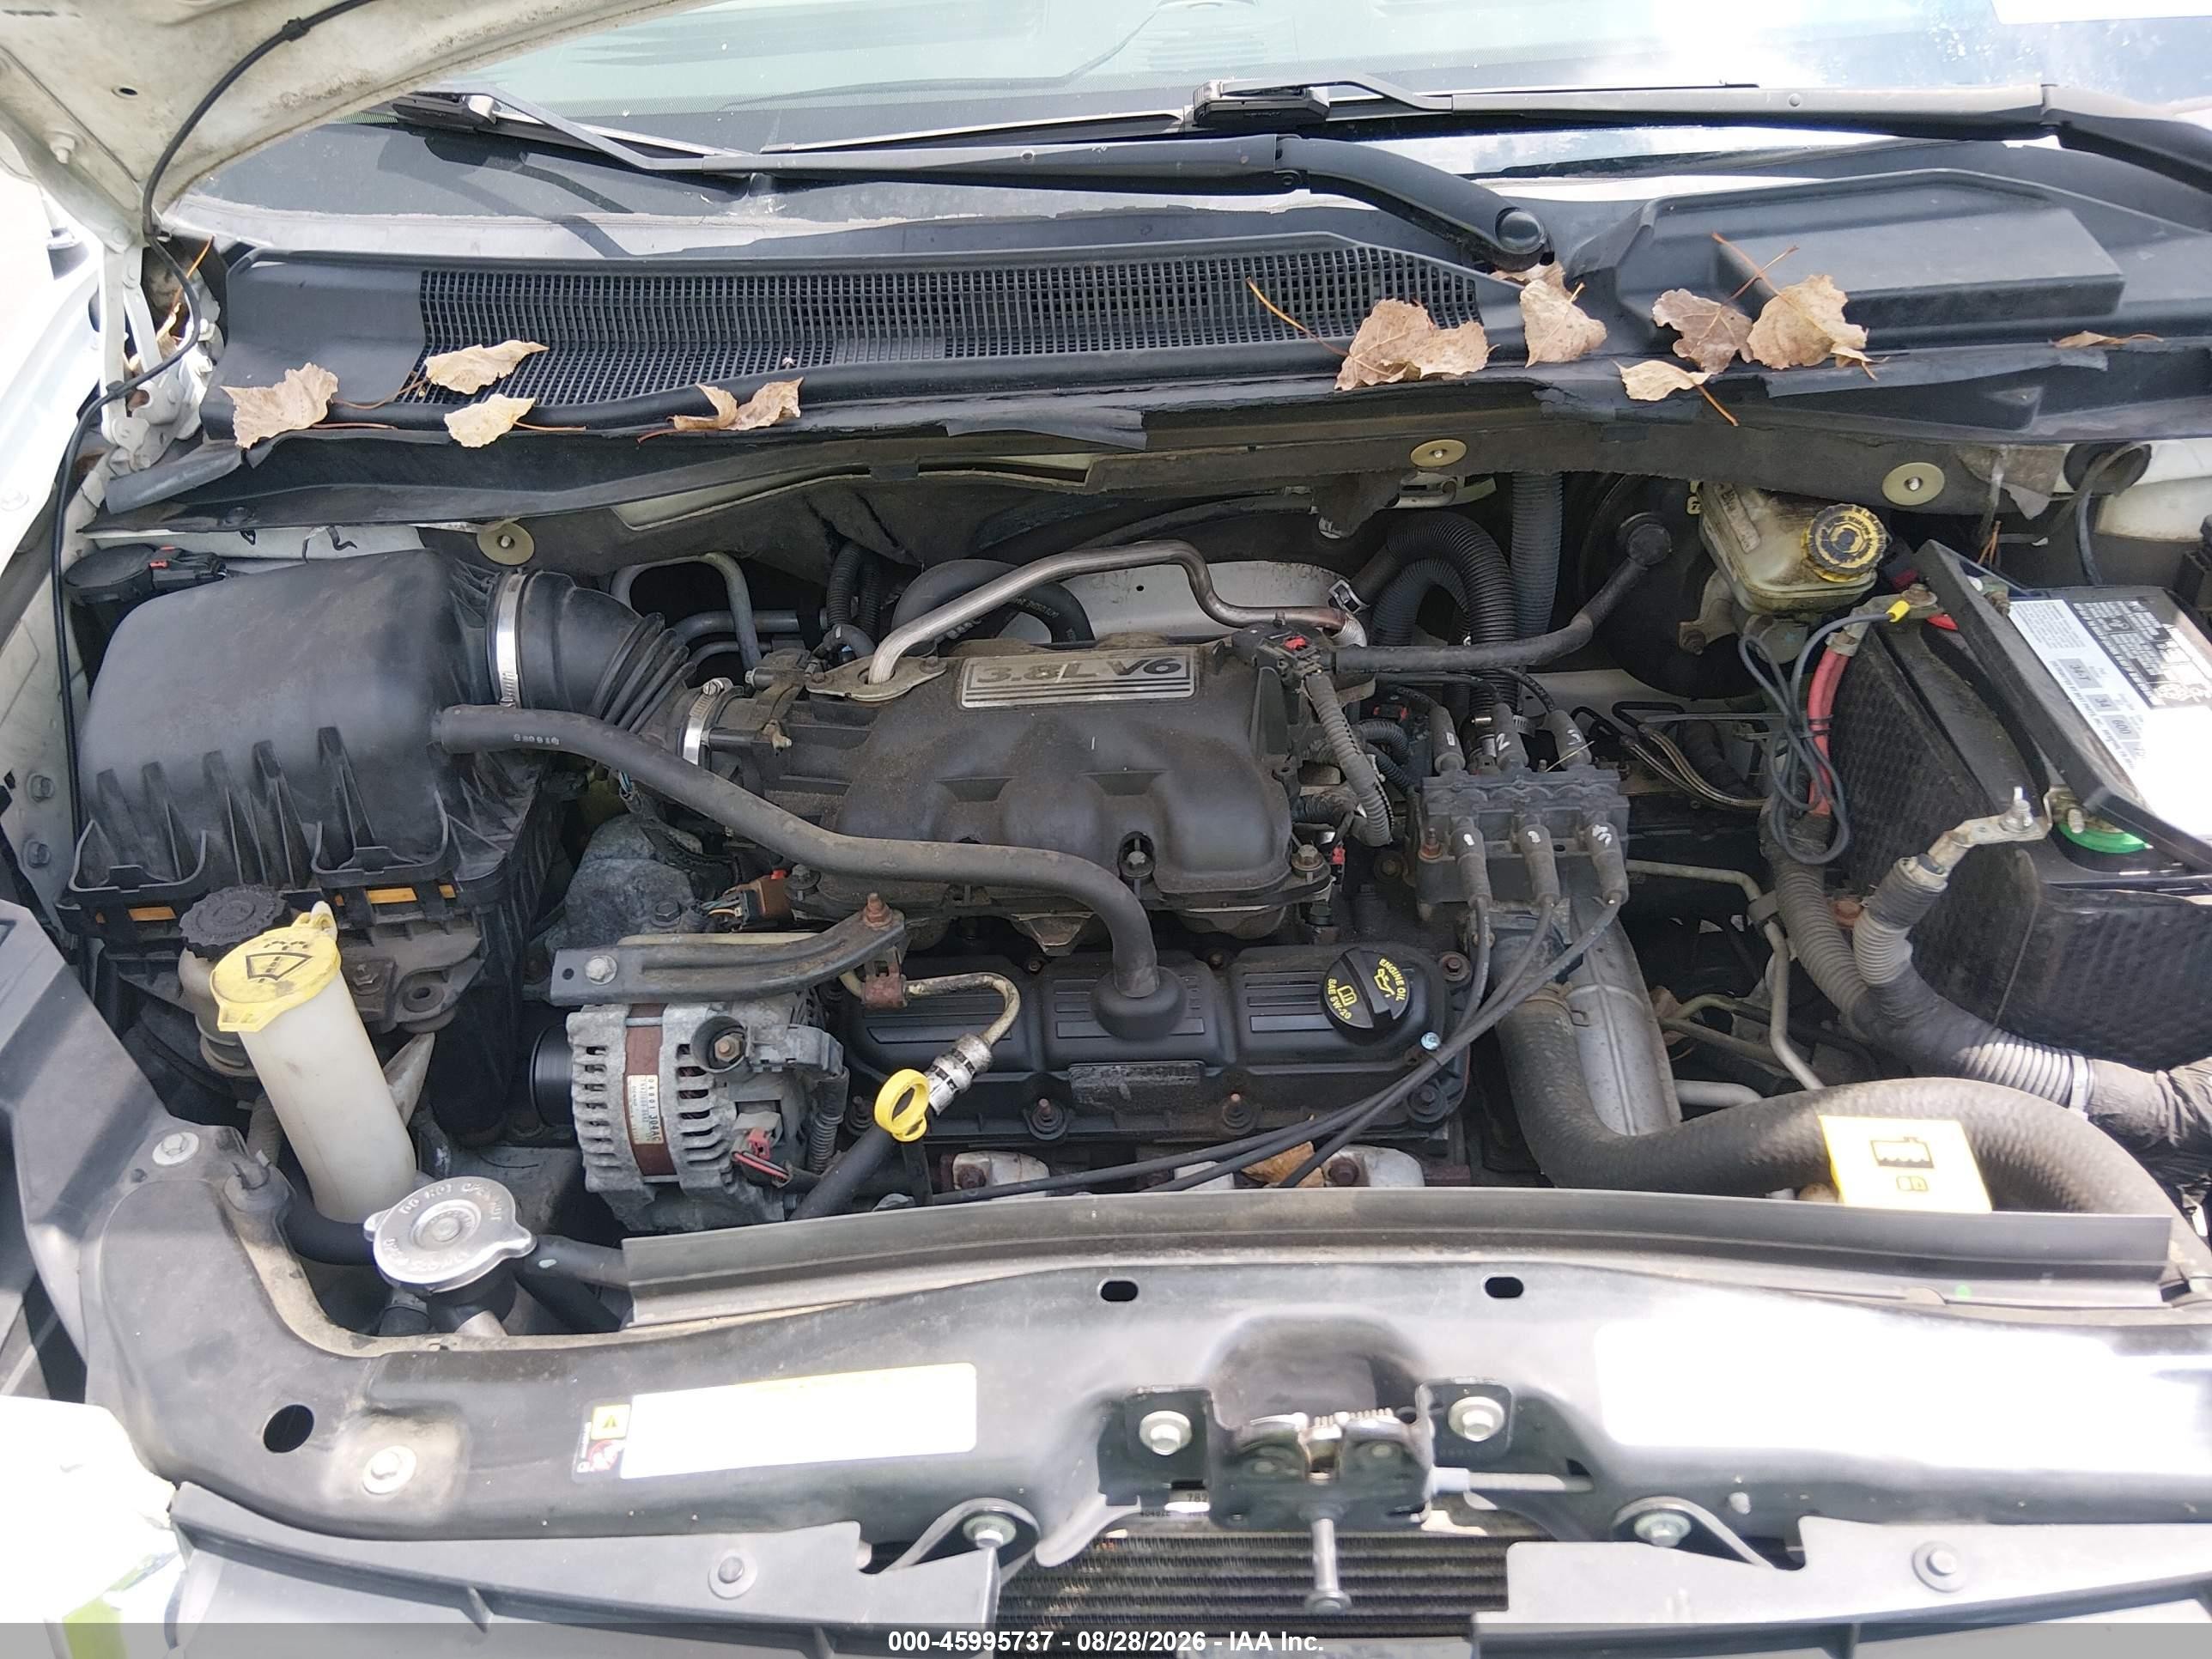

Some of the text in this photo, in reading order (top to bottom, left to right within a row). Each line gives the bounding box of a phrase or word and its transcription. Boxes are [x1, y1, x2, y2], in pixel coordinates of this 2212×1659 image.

[976, 657, 1182, 684] 3.8L V6
[1328, 978, 1338, 995] SAE
[1378, 957, 1407, 1001] ENGINE OIL
